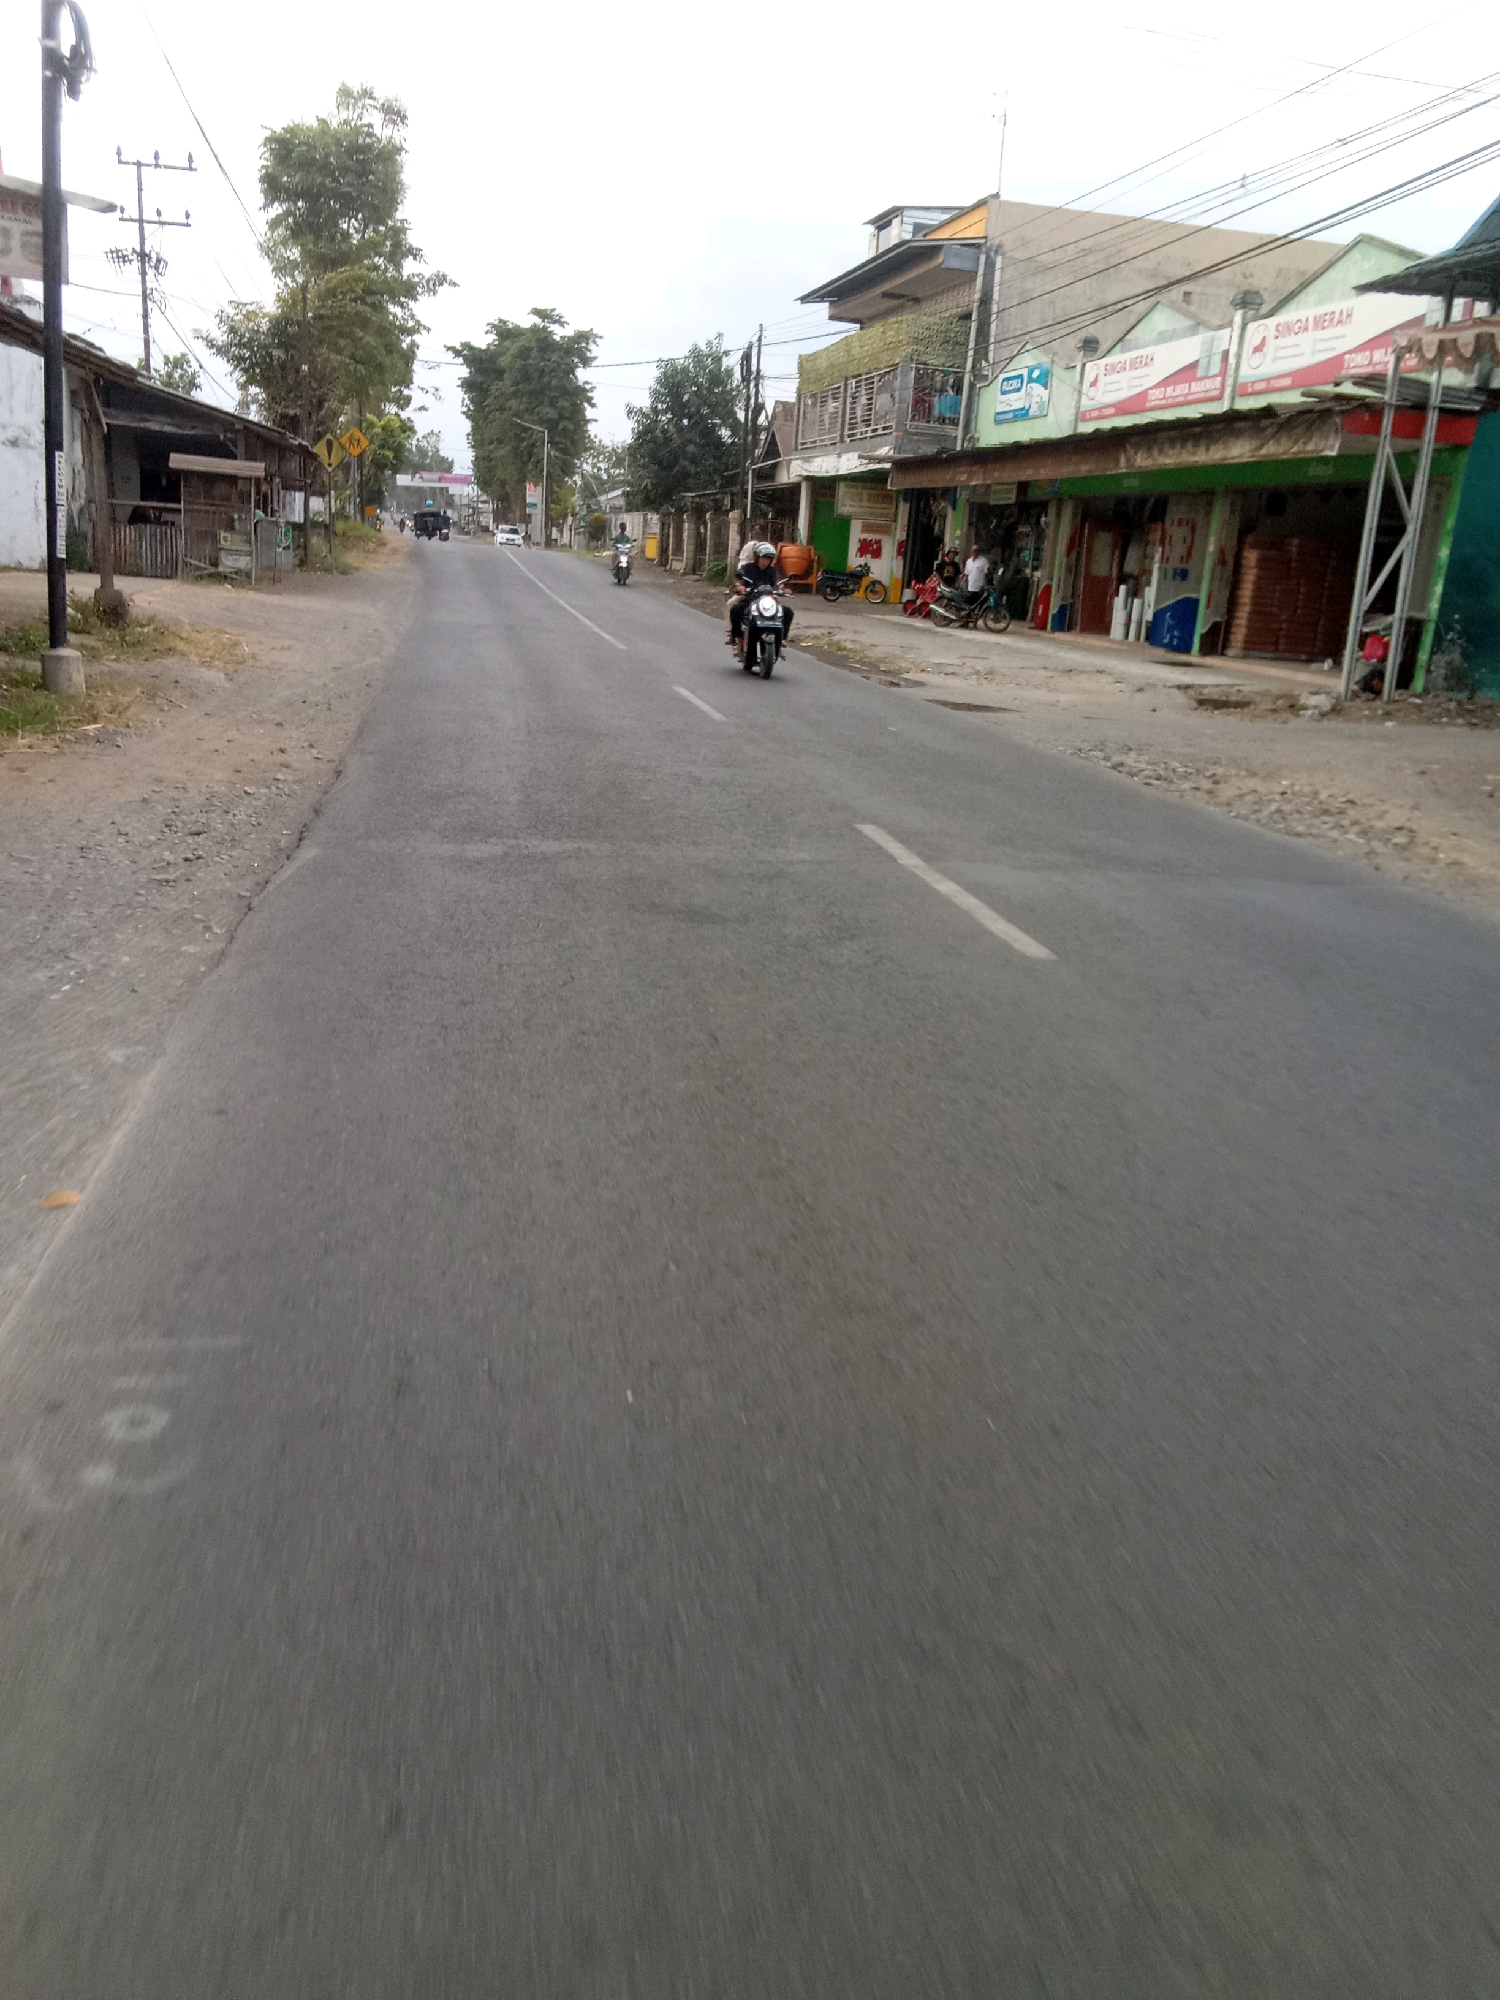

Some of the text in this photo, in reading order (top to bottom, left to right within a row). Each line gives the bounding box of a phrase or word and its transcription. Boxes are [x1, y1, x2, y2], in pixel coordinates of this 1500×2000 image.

[1273, 306, 1354, 340] SINGA MERAH
[1103, 352, 1155, 377] SINGA MERAH
[1343, 351, 1371, 368] TOKO
[1147, 387, 1166, 401] TOKO
